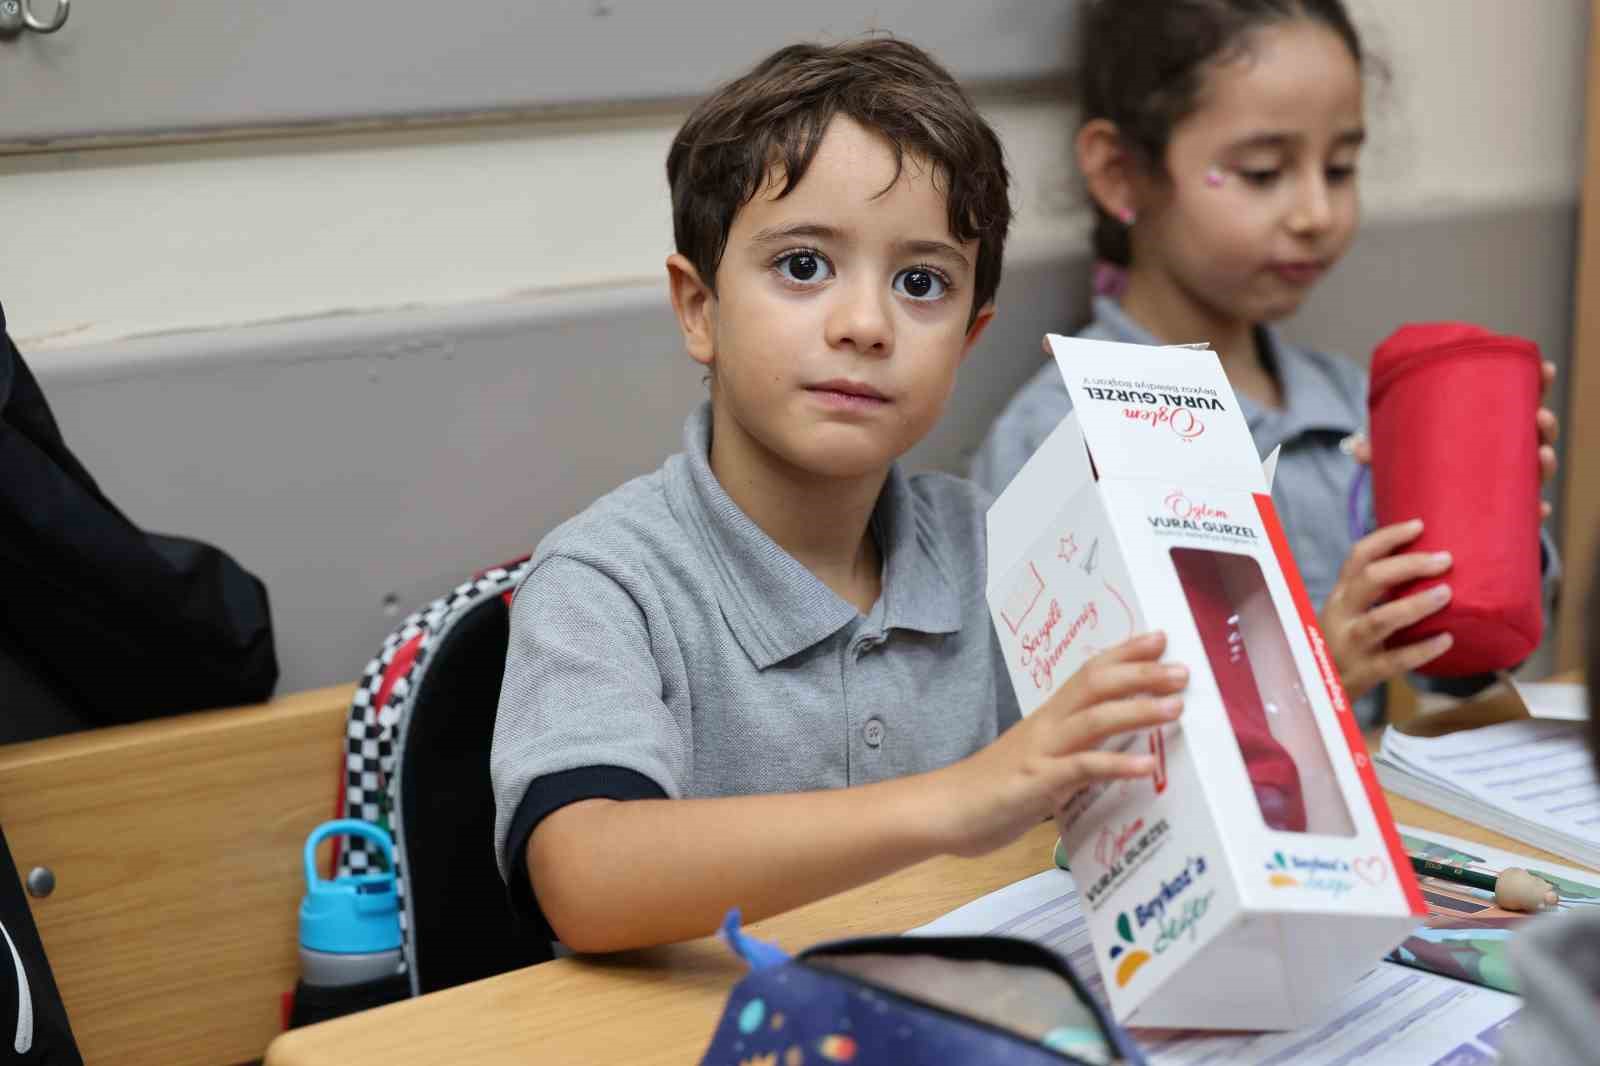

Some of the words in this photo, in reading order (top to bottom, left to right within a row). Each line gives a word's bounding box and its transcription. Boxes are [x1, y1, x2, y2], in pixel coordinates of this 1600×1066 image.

[1159, 393, 1226, 411] VURAL
[1123, 405, 1205, 443] Özlem
[1146, 515, 1200, 531] VURAL
